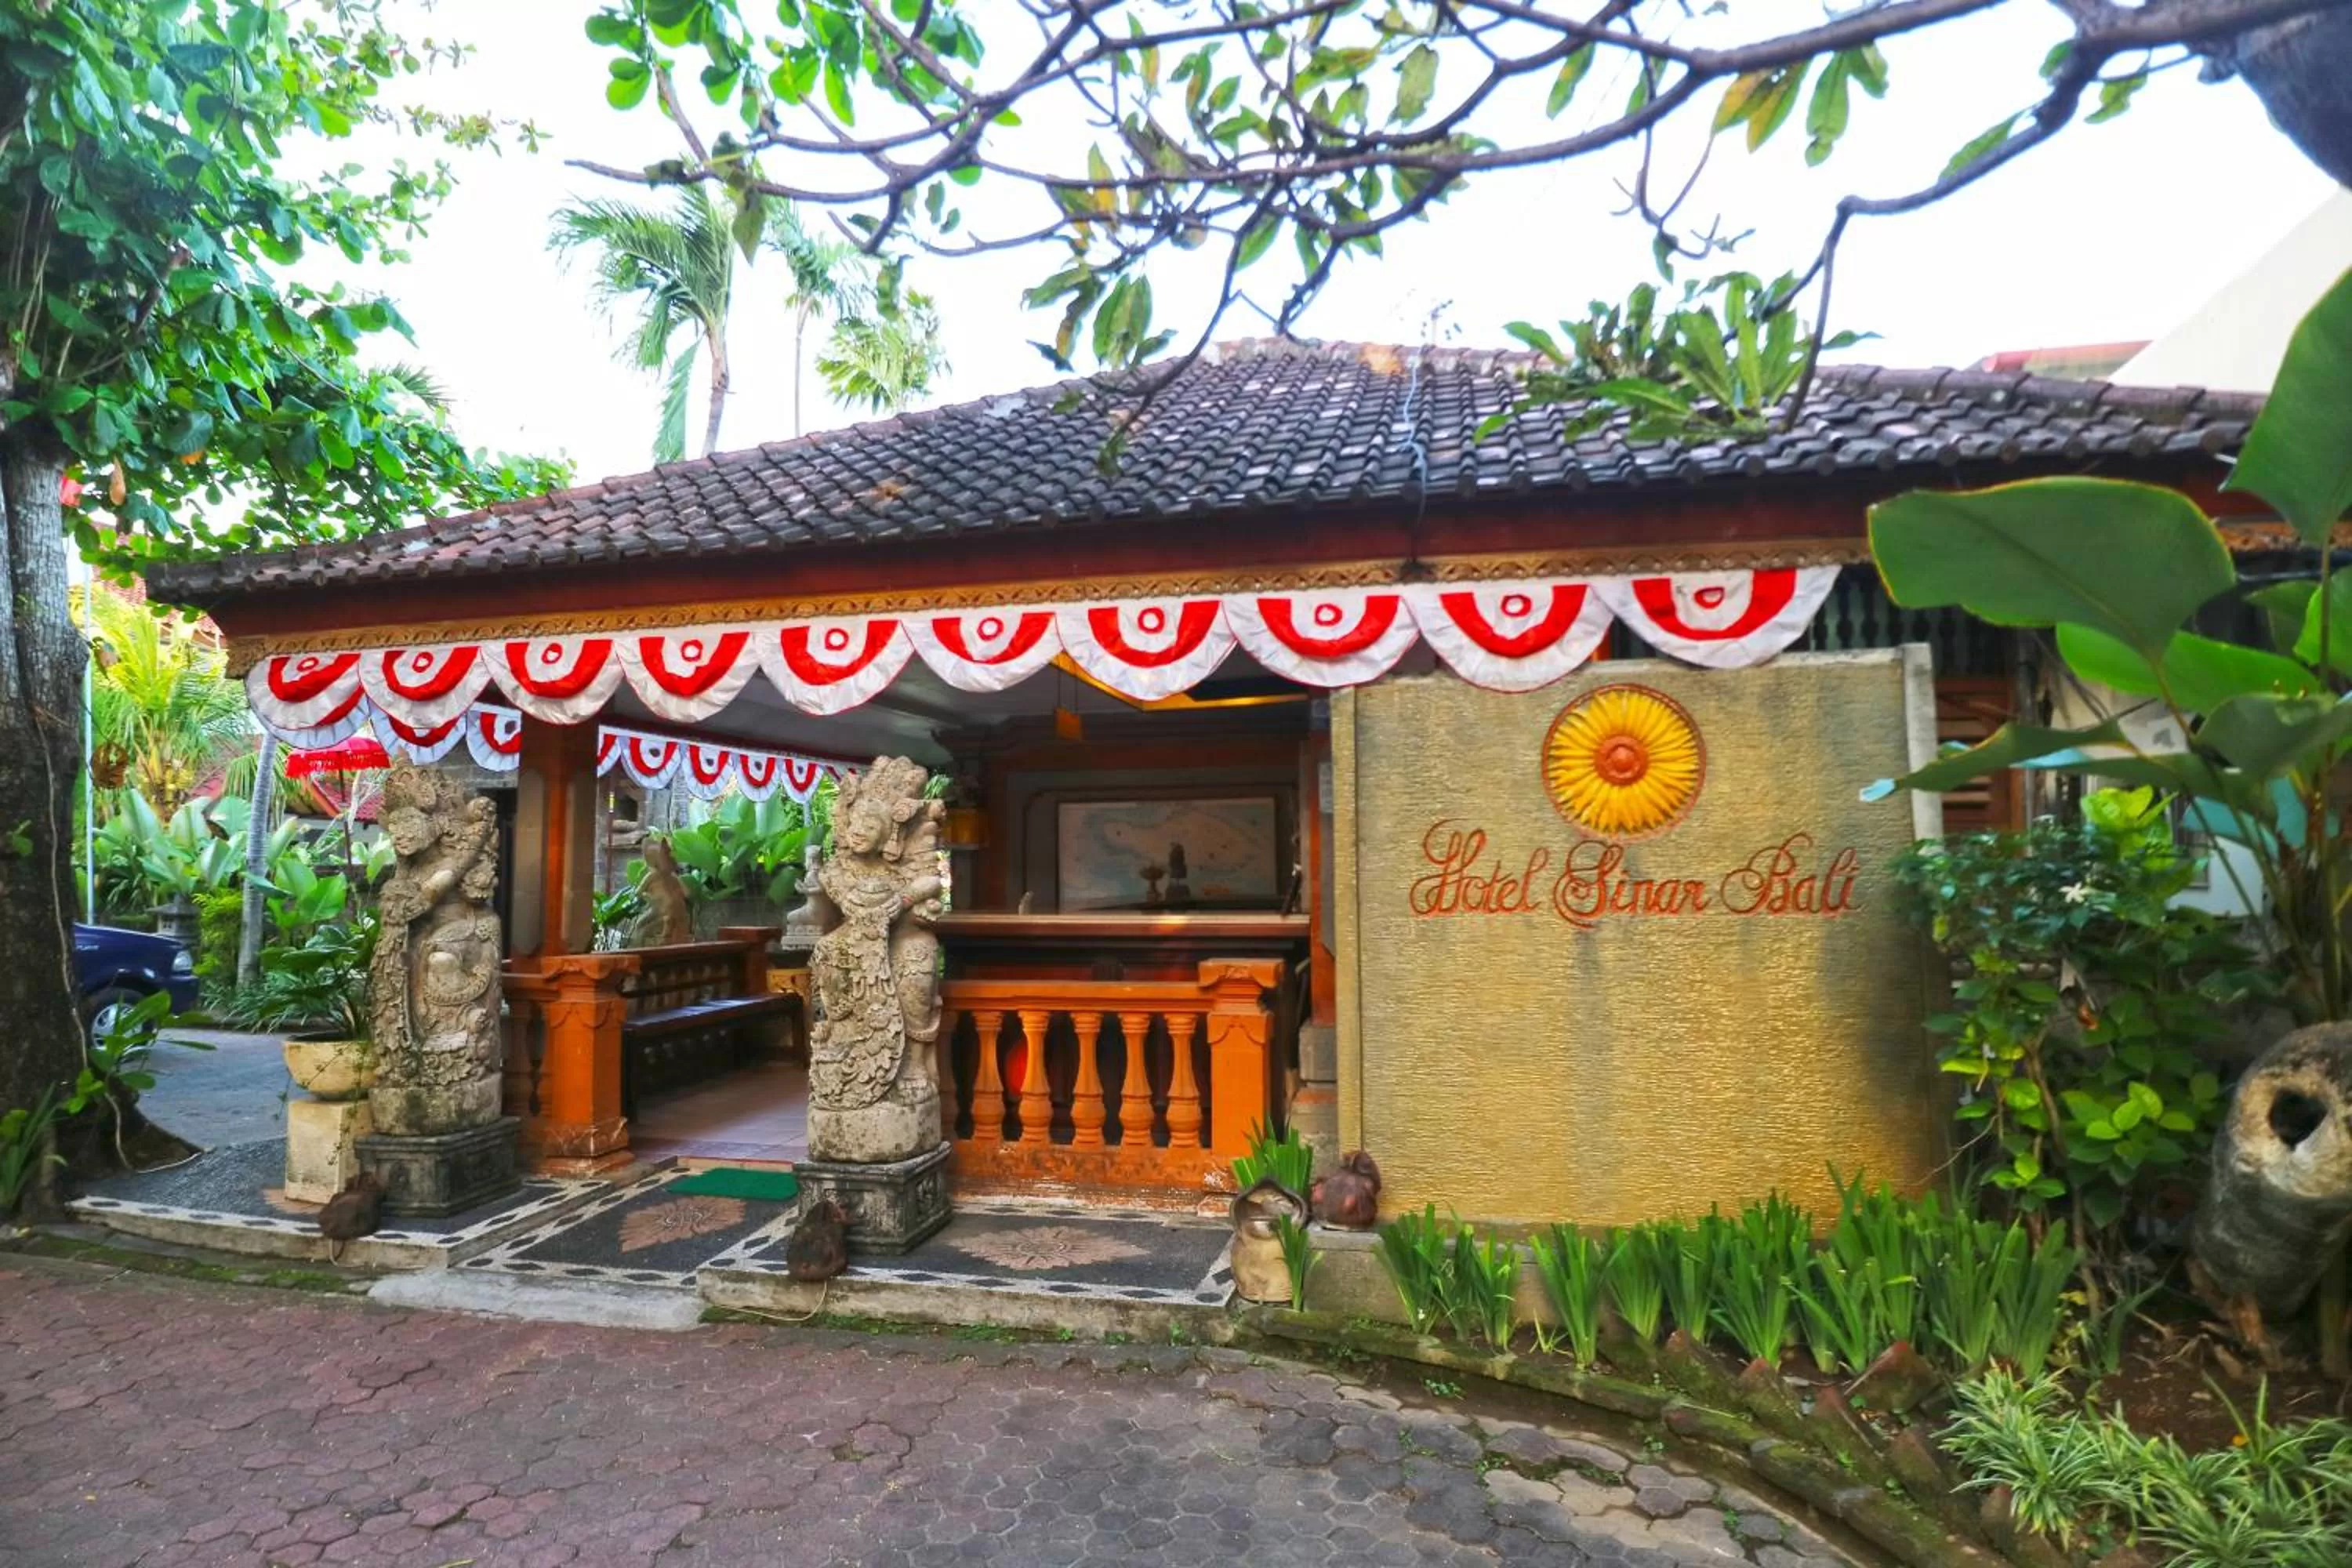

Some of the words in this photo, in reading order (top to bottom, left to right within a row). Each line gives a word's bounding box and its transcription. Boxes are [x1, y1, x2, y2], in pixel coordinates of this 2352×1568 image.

[1410, 818, 1549, 916] Hotel
[1554, 840, 1712, 928] Sinar
[1720, 833, 1866, 916] Bali
